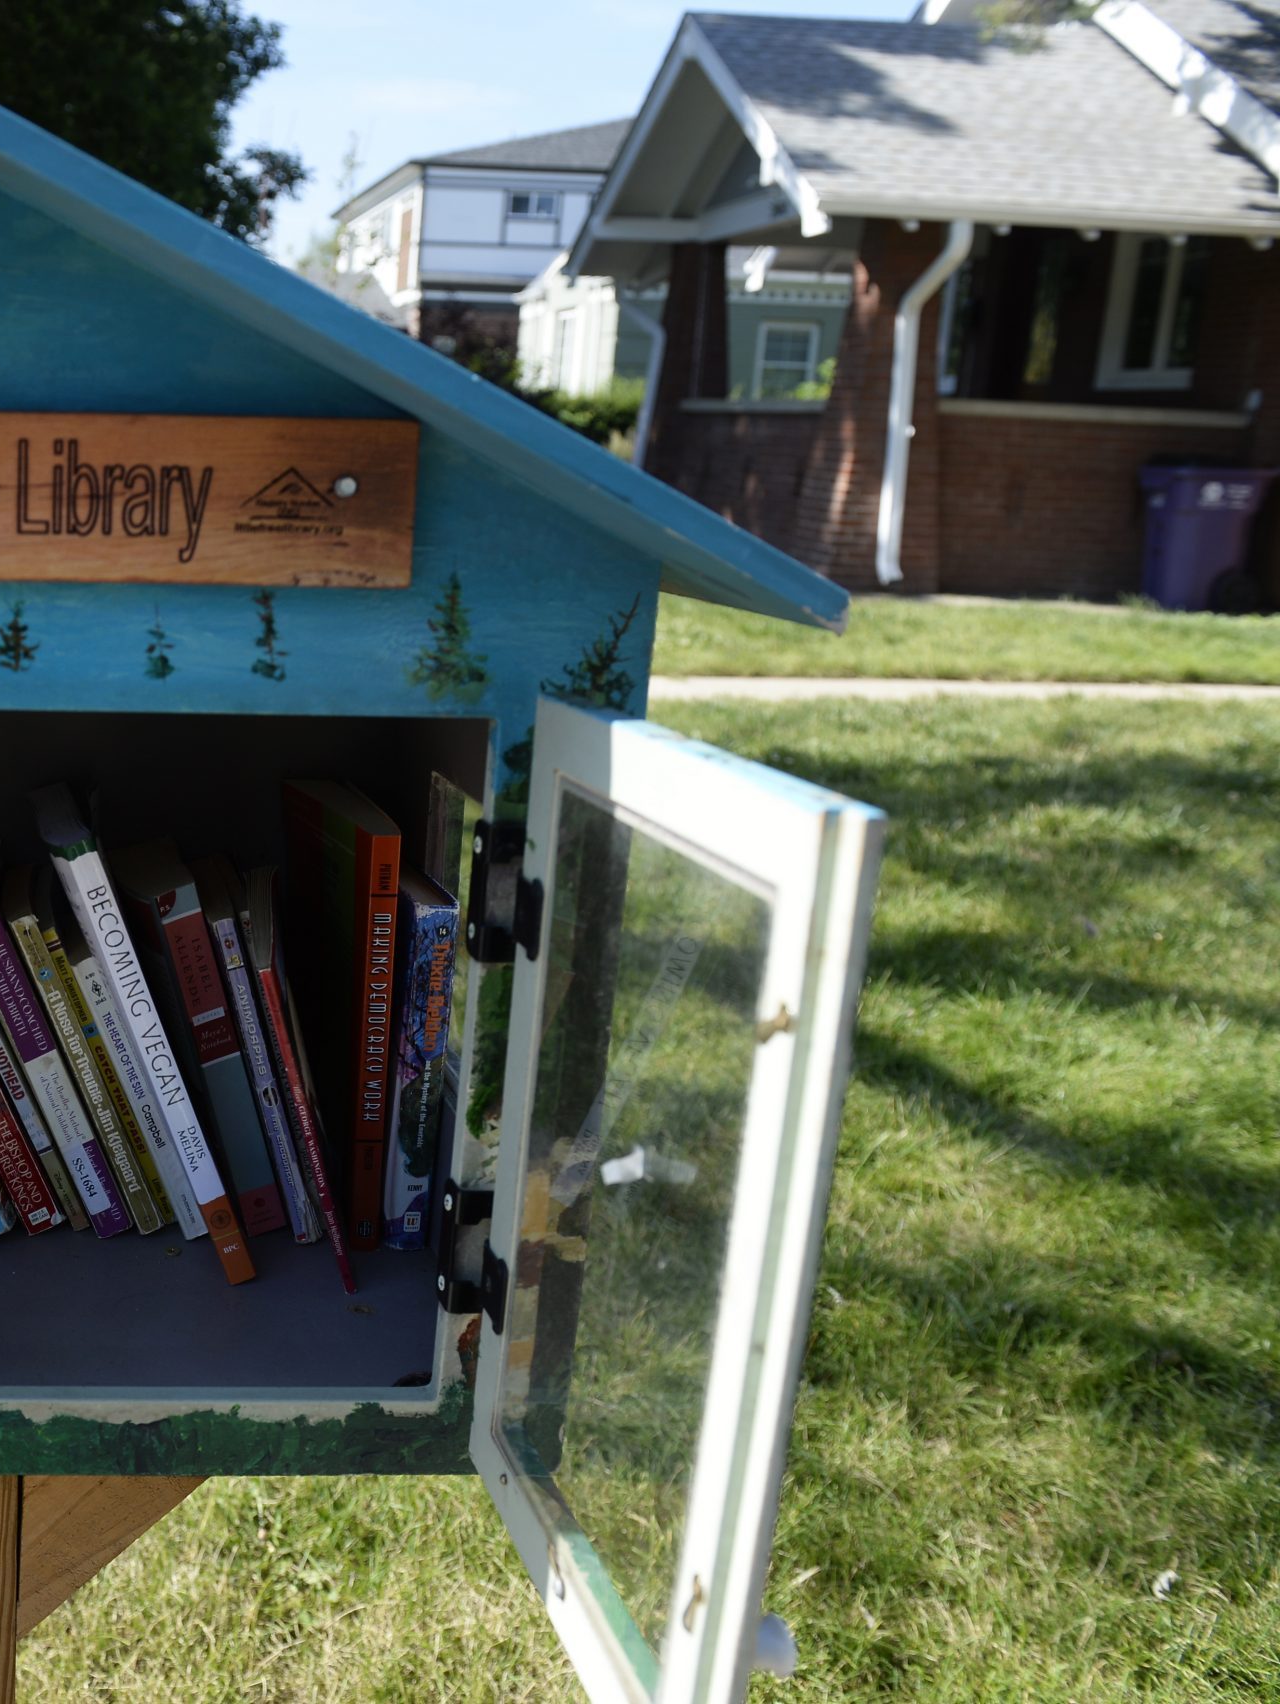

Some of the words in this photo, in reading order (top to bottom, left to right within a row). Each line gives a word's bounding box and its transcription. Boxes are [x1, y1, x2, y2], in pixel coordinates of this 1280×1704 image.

[16, 438, 214, 563] Library
[55, 955, 67, 977] MATT
[192, 937, 213, 992] ISABEL
[371, 913, 392, 975] MAKING
[430, 941, 452, 991] Trixie
[175, 935, 201, 1008] ALLENDE
[87, 884, 151, 1018] BECOMING
[141, 1022, 185, 1106] VEGAN
[102, 1012, 115, 1029] THE
[108, 1027, 127, 1055] HEART
[237, 984, 267, 1076] ANIMORPHS
[365, 983, 388, 1072] DEMOCRACY
[423, 995, 446, 1052] Belden
[94, 1045, 116, 1083] CATCH
[113, 1087, 130, 1118] THAT
[120, 1054, 132, 1067] OF
[126, 1065, 139, 1084] THE
[132, 1081, 146, 1099] SUN
[362, 1079, 382, 1121] WORK
[142, 1104, 166, 1149] Campbell
[187, 1126, 205, 1159] DAVIS
[298, 1103, 312, 1137] GEORGE
[307, 1137, 328, 1191] WASHINGTON
[6, 1136, 33, 1180] BISHOP
[23, 1179, 43, 1203] AND
[177, 1130, 199, 1173] MELINA
[8, 1177, 34, 1212] KINGS
[72, 1157, 97, 1198] SS-1684
[223, 1243, 241, 1254] BPC
